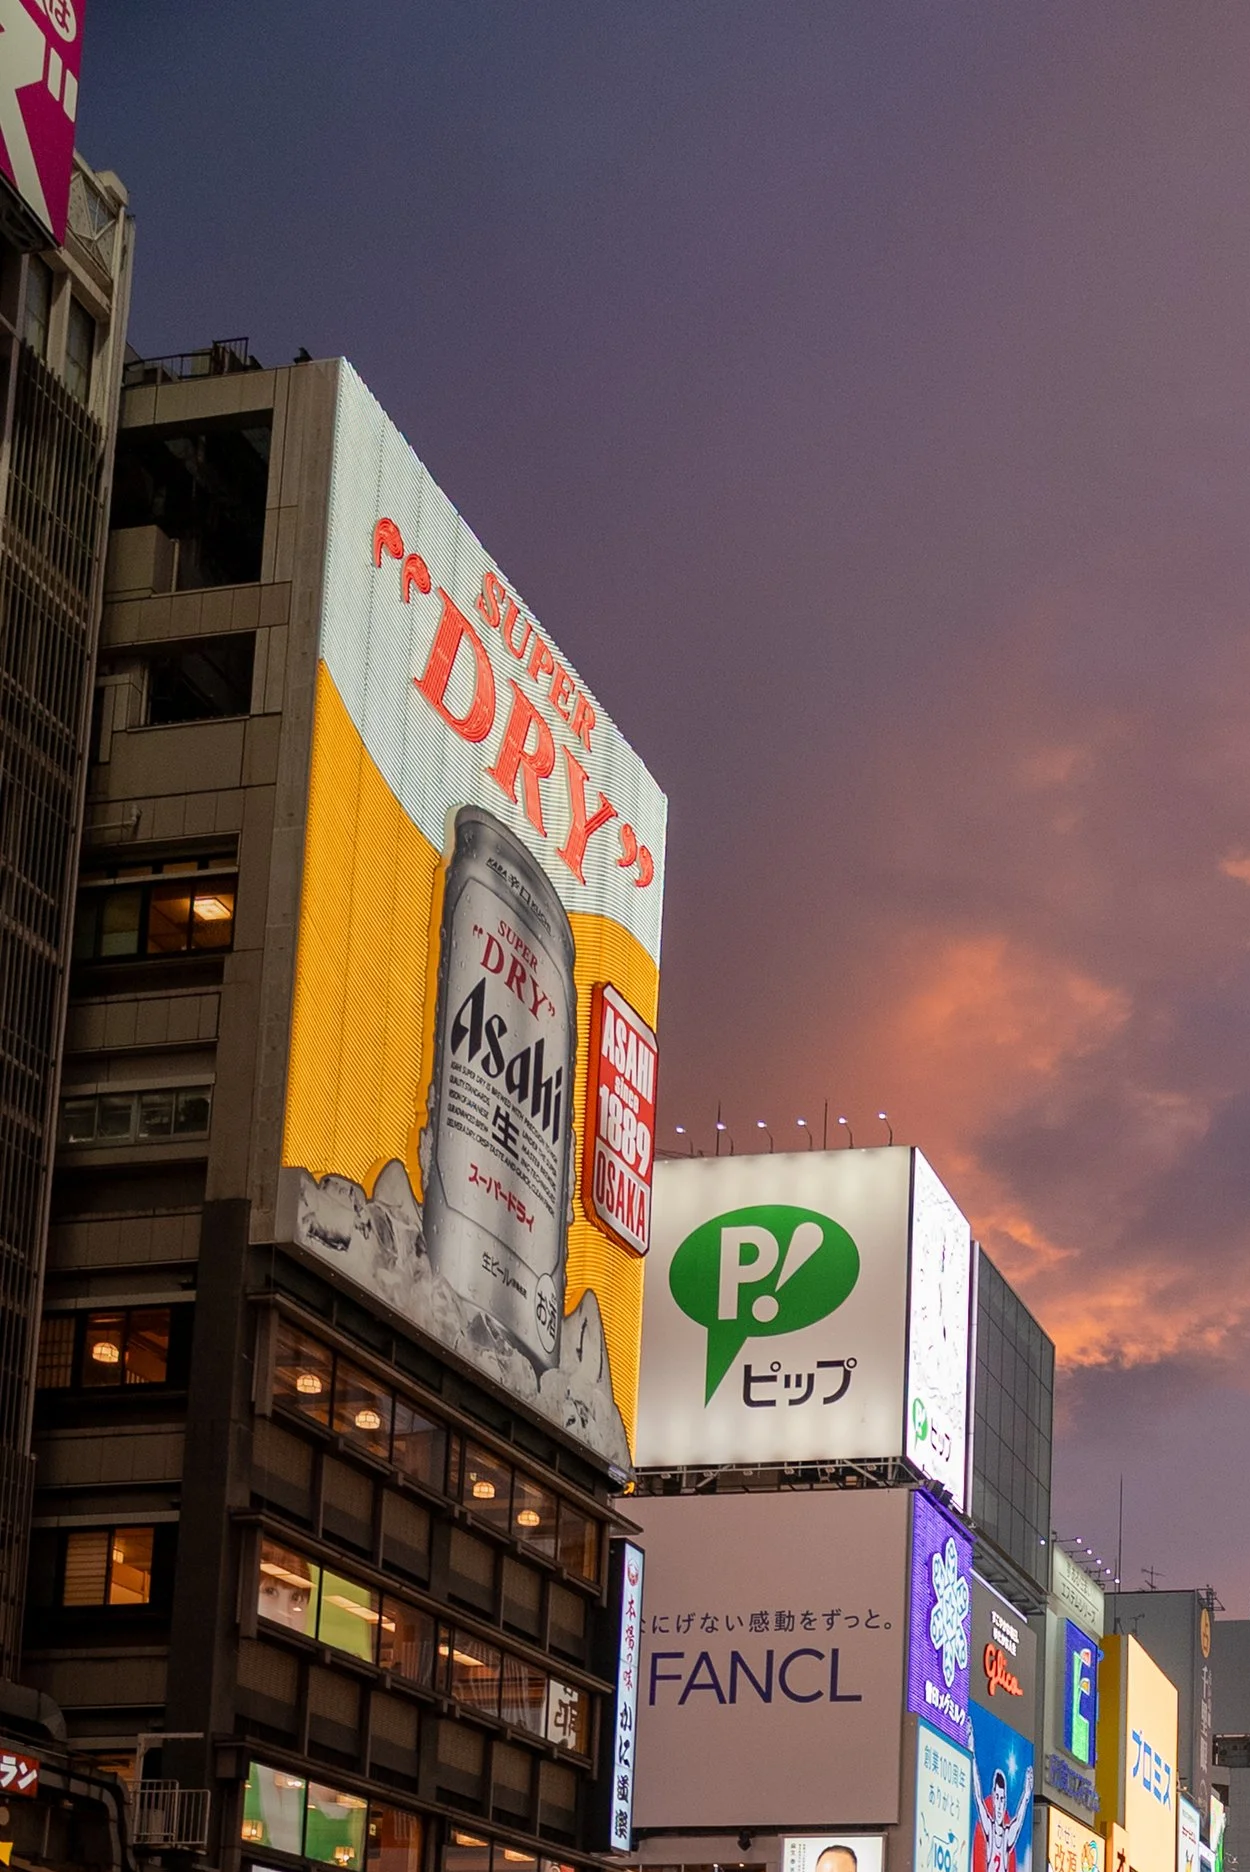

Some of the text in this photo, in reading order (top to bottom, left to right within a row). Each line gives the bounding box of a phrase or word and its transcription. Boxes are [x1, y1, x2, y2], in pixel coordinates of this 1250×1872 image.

[476, 572, 596, 753] SUPER
[498, 920, 538, 973] SUPER
[451, 977, 563, 1145] Asahi
[602, 1005, 655, 1104] ASAHI
[614, 1075, 640, 1114] since
[491, 1105, 520, 1161] 生
[600, 1083, 651, 1177] 1889
[468, 1163, 535, 1233] スーパードライ
[596, 1148, 646, 1243] OSAKA
[742, 1357, 857, 1408] ピップ
[649, 1648, 862, 1706] FANCL
[983, 1642, 1024, 1697] Glico
[1131, 1729, 1172, 1812] プロミス
